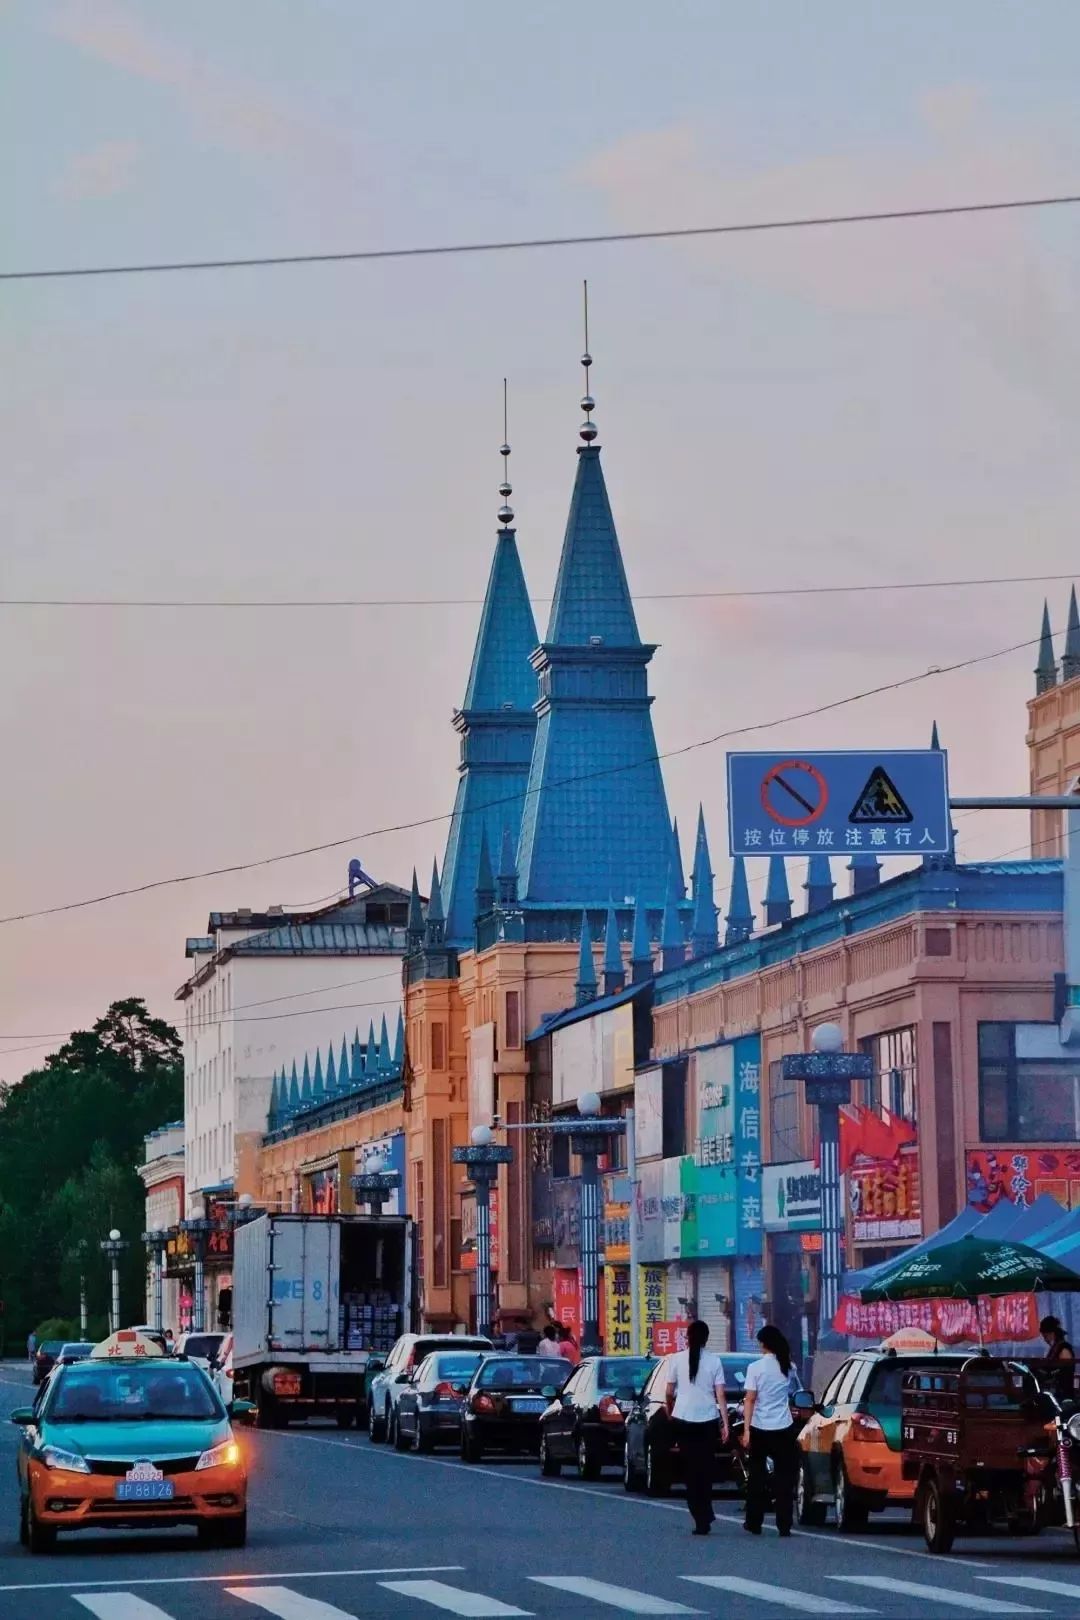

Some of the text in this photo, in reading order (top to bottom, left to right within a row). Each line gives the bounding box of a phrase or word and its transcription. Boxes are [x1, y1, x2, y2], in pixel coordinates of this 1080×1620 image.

[743, 827, 936, 846] 按位停放 注意行人
[739, 1061, 761, 1229] 海信专卖
[908, 1264, 942, 1272] BEER
[977, 1257, 1021, 1279] HARBIN
[107, 1344, 148, 1356] 北极
